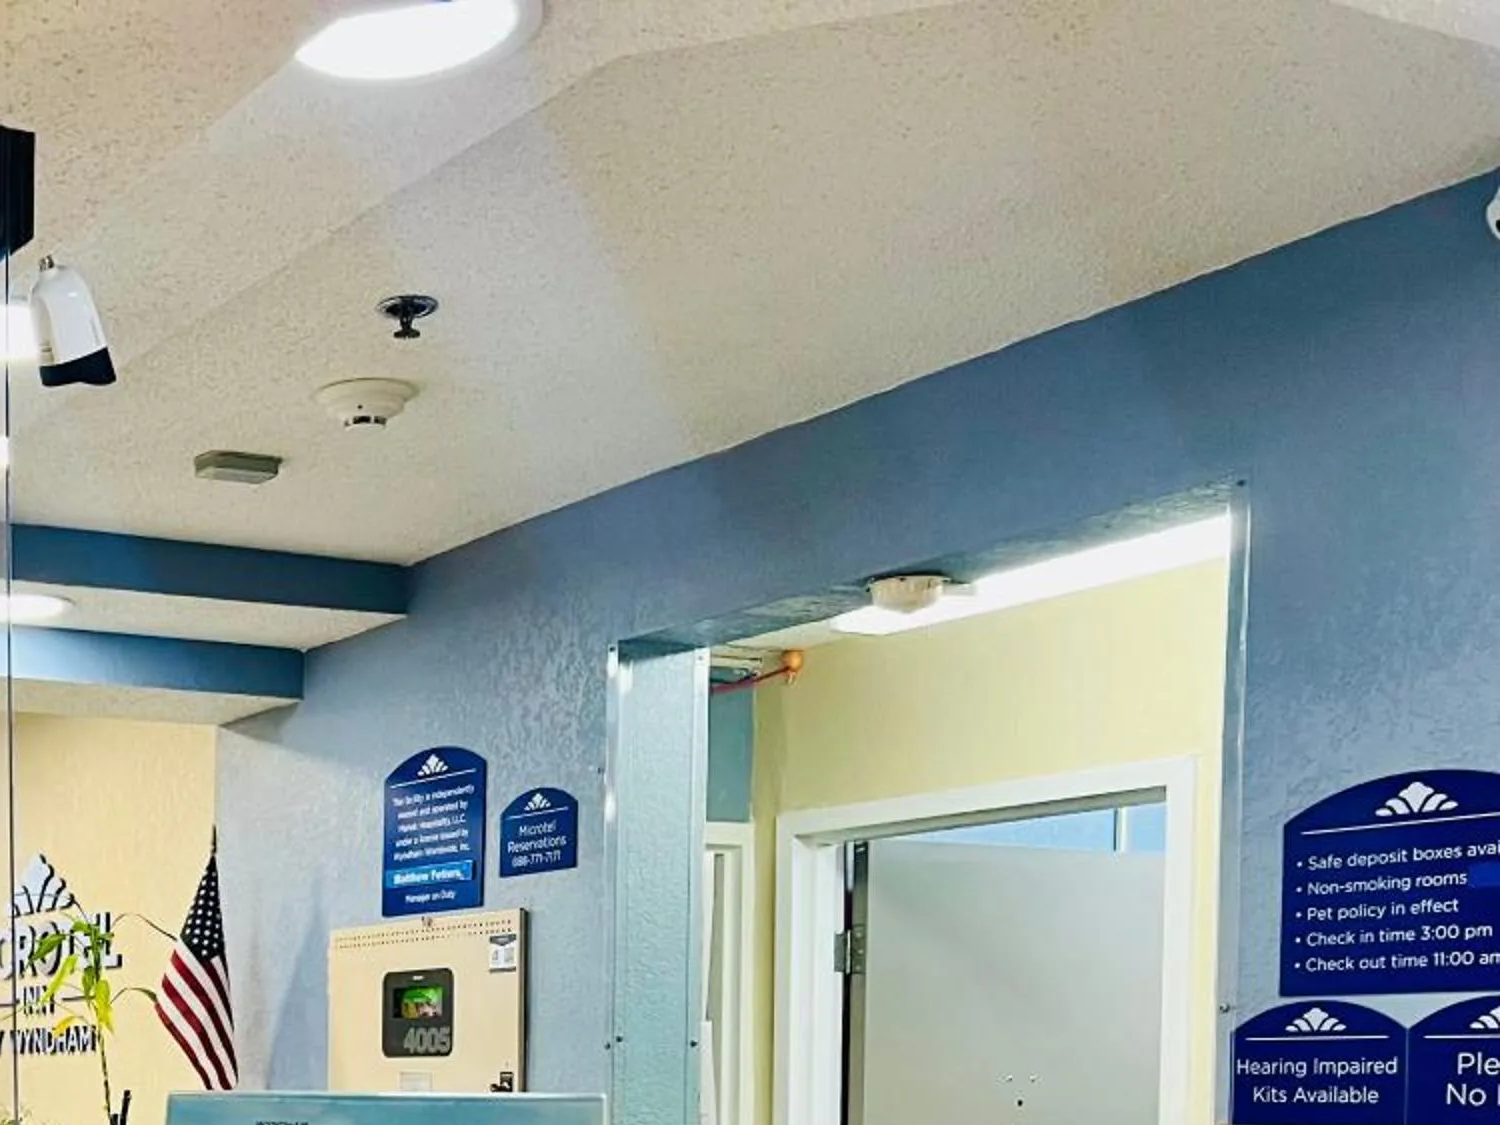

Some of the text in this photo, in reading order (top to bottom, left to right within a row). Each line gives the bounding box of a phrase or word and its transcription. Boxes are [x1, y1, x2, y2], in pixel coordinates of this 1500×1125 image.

[519, 820, 557, 836] Microtel
[508, 836, 567, 853] Reservations
[1307, 854, 1342, 871] Safe
[1347, 849, 1408, 867] deposit
[1413, 847, 1462, 860] boxes
[1307, 872, 1467, 895] Non-smoking rooms
[1307, 899, 1459, 921] Pet policy in effect
[1306, 925, 1493, 946] Check in time 3:00 pm
[1305, 957, 1354, 972] Check
[1359, 956, 1386, 969] out
[1391, 953, 1428, 968] time
[1433, 951, 1475, 966] 11:00
[10, 1025, 97, 1056] WYNDHAM
[403, 1026, 450, 1054] 4005
[1236, 1056, 1398, 1077] Hearing Impaired
[1253, 1085, 1379, 1104] Kits Available
[1446, 1083, 1487, 1106] No
